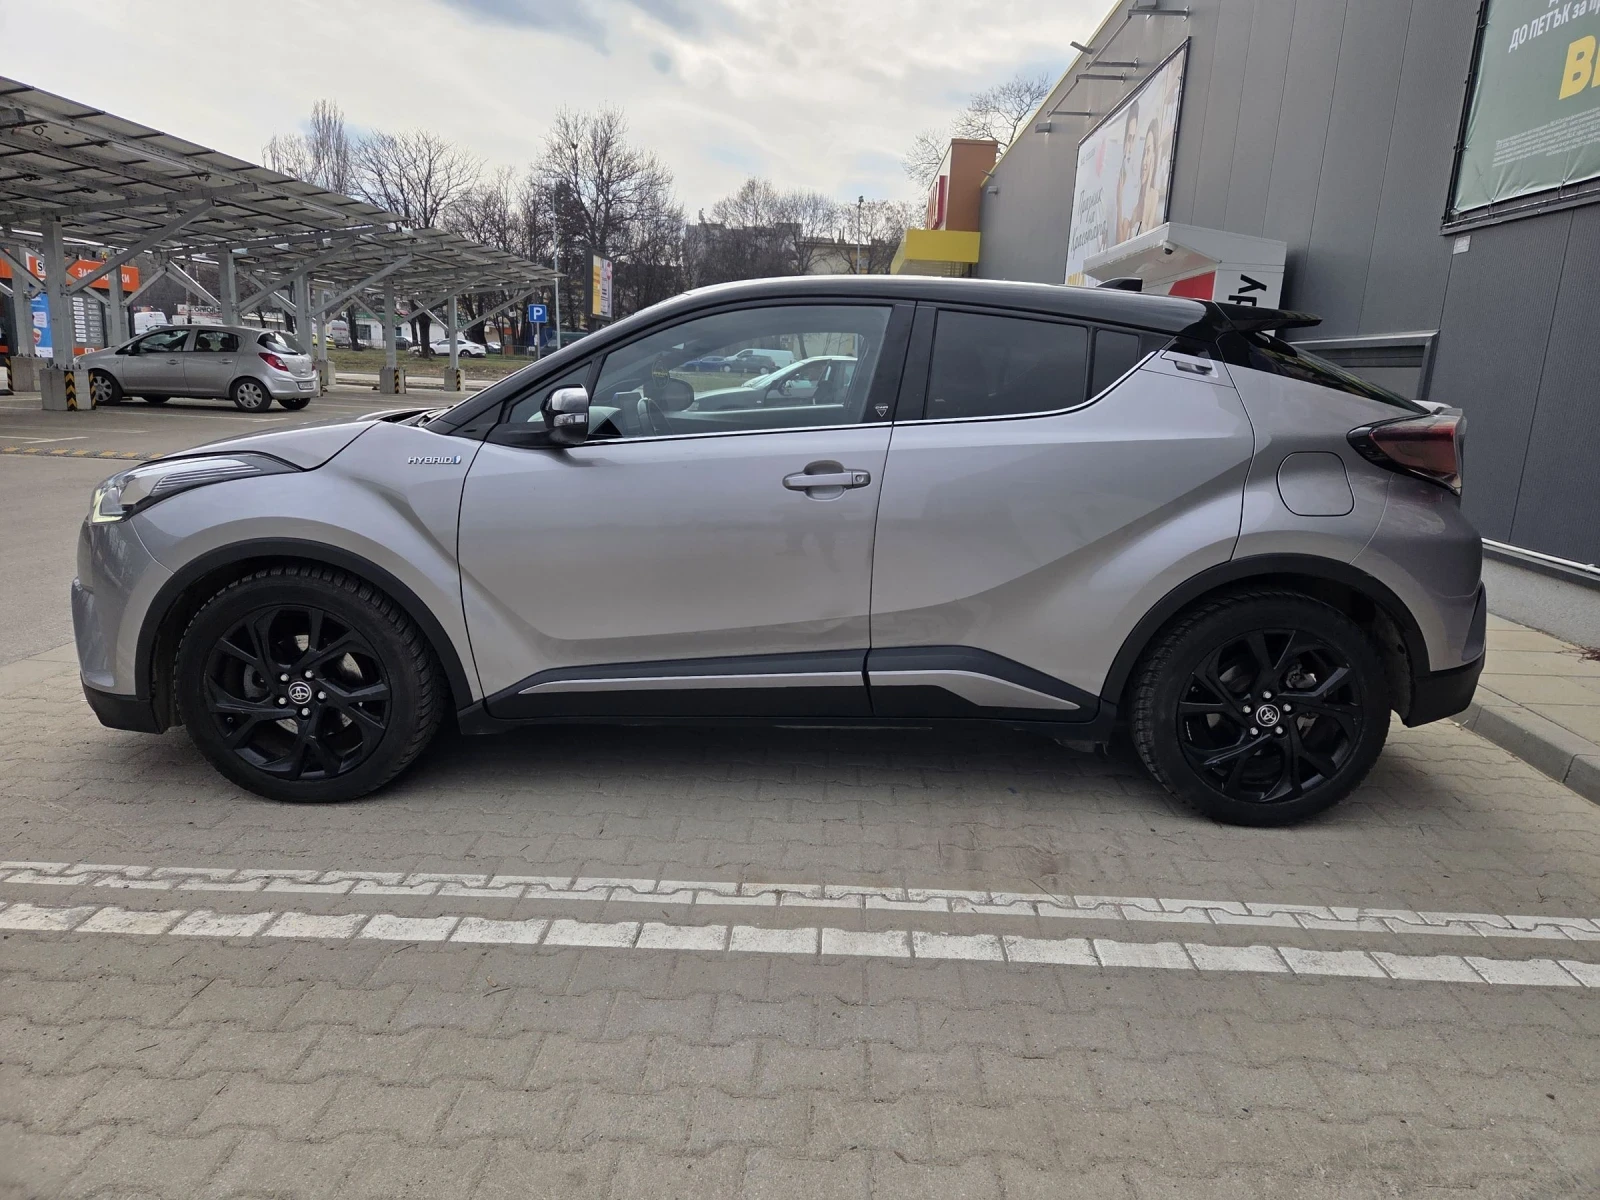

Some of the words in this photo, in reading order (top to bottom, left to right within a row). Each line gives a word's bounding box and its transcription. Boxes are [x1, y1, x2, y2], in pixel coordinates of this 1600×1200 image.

[1508, 24, 1528, 53] ДО
[1529, 2, 1572, 40] ПЕТЪК
[533, 307, 543, 320] P
[408, 456, 453, 464] HYBRID
